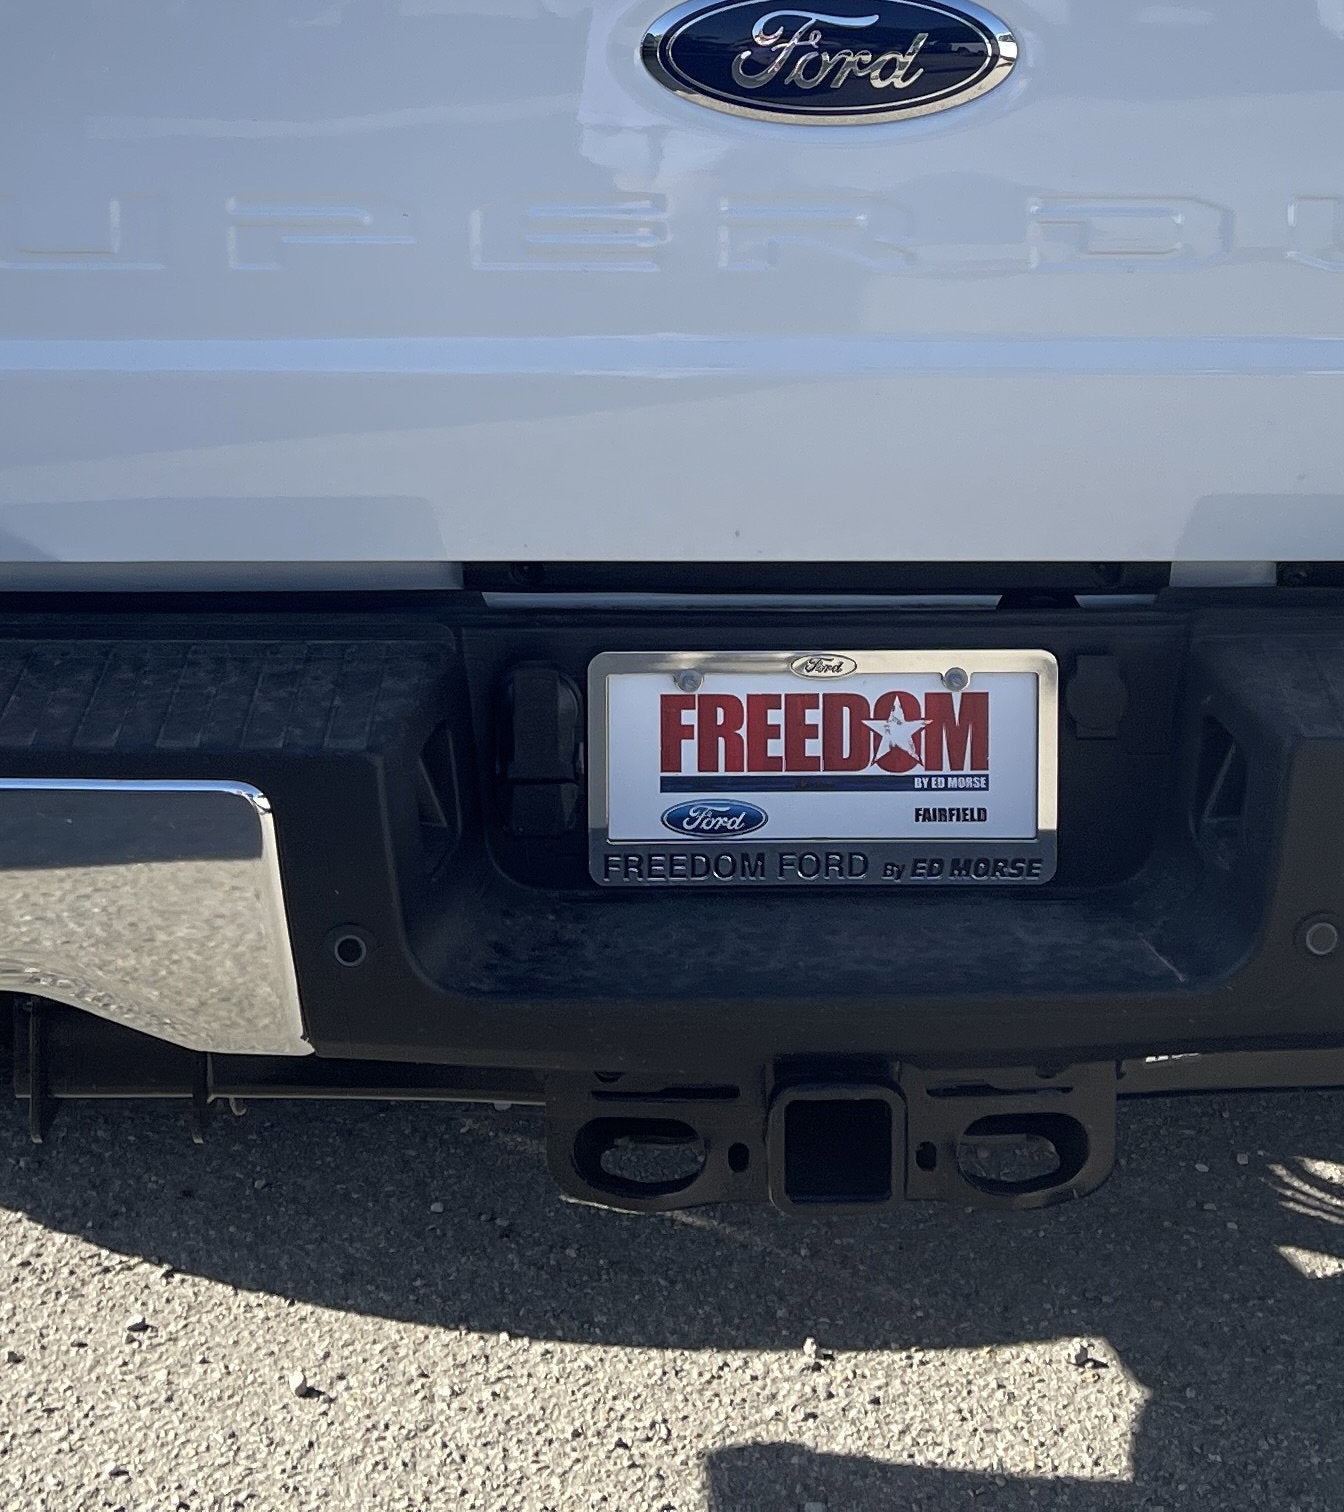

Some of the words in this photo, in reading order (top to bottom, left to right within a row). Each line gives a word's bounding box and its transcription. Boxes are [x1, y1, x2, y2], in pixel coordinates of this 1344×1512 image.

[732, 9, 929, 89] Ford
[804, 657, 844, 673] Ford
[660, 690, 989, 773] FREEDOM
[913, 777, 929, 789] BY
[931, 777, 945, 789] ED
[947, 776, 987, 789] MORSE
[682, 805, 747, 832] Ford
[914, 807, 988, 823] FAIRFIELD
[603, 852, 767, 881] FREEDOM
[777, 851, 870, 880] FORD
[910, 858, 945, 880] ED
[948, 857, 1044, 879] MORSE
